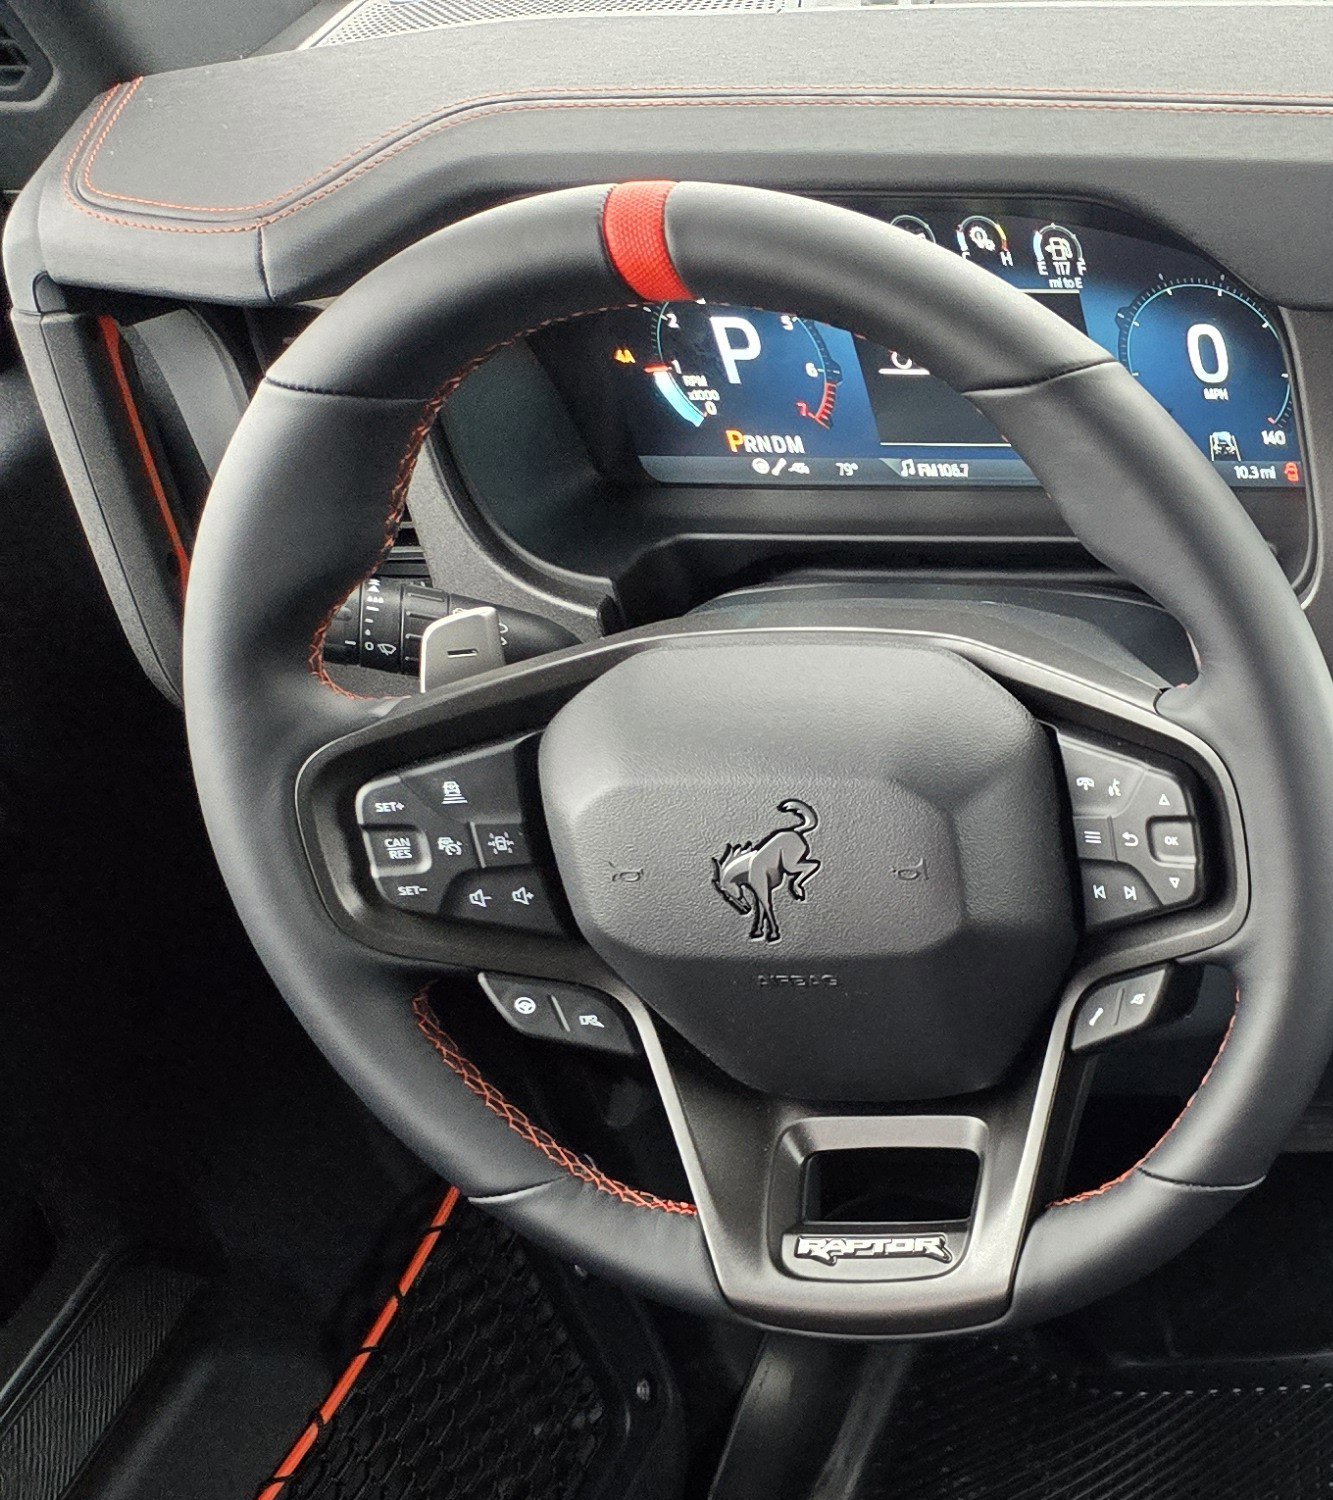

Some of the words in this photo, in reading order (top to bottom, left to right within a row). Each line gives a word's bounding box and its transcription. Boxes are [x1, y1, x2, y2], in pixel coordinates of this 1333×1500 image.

[1000, 251, 1014, 267] H
[1037, 261, 1048, 275] E
[1053, 261, 1070, 276] 117
[1077, 258, 1087, 276] F
[667, 313, 679, 328] 2
[780, 315, 794, 330] 5
[708, 316, 762, 384] P
[1187, 323, 1229, 384] 0
[805, 363, 818, 378] 6
[682, 374, 708, 387] RPM
[1203, 387, 1230, 400] MPH
[704, 401, 718, 416] 0
[796, 401, 807, 416] 7
[725, 429, 805, 455] PRNDM
[1261, 430, 1286, 446] 140
[384, 837, 411, 848] CAN
[1164, 835, 1179, 846] OK
[388, 848, 413, 860] RES
[796, 1236, 950, 1261] RAPTOR
